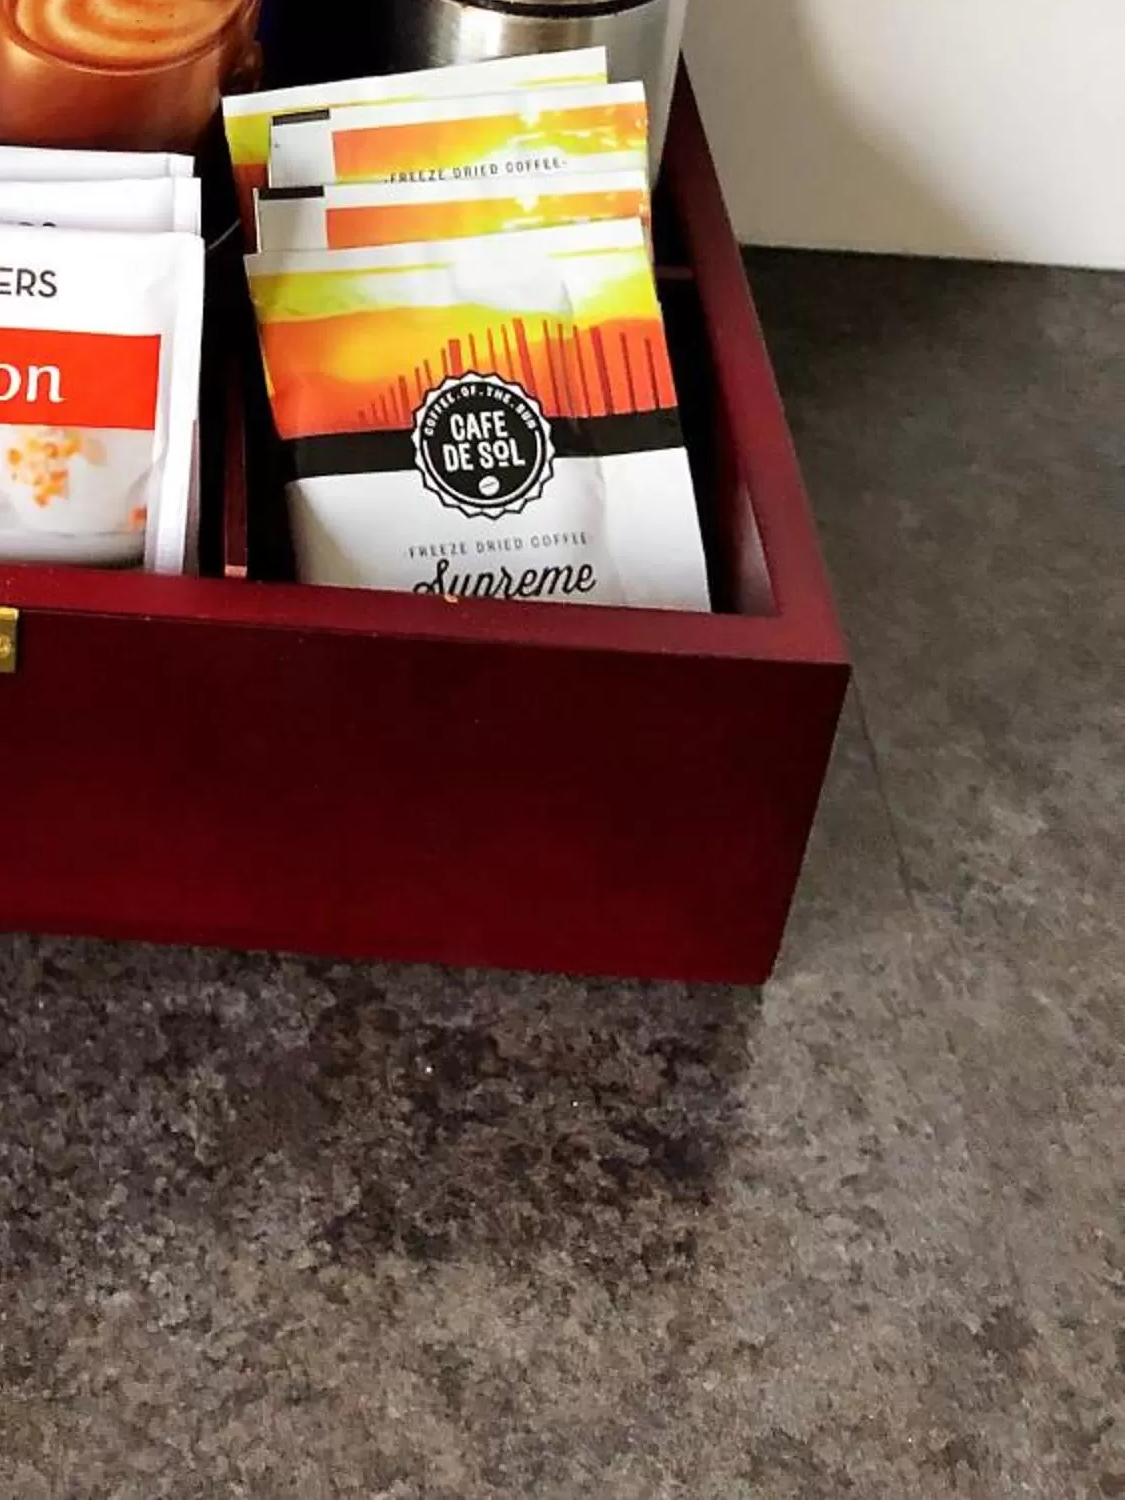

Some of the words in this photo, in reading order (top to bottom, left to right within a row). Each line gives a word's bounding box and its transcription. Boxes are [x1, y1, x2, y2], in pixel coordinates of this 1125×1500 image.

[452, 162, 499, 180] DRIED
[450, 410, 509, 442] CAFE
[442, 441, 475, 472] DE
[476, 537, 524, 554] DRIED
[530, 531, 588, 549] COFFEE
